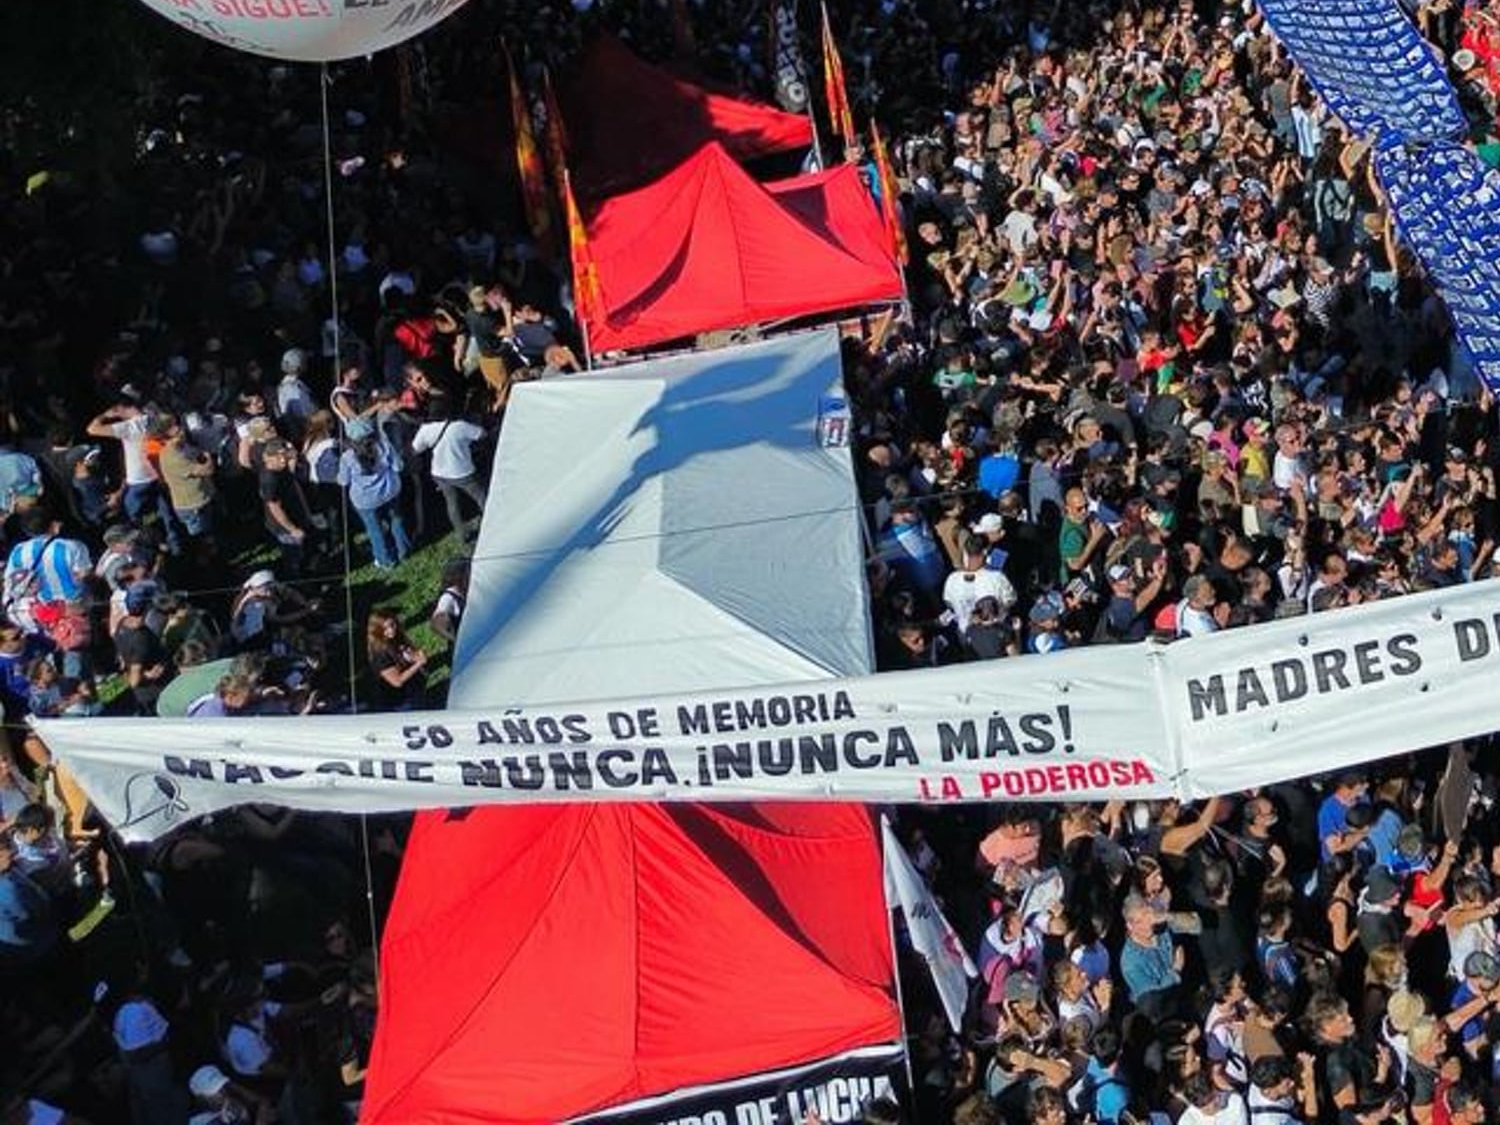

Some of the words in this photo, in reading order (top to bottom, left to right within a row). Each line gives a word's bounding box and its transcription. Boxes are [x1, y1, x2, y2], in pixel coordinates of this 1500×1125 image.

[1187, 632, 1422, 721] MADRES
[402, 725, 454, 750] 50
[477, 709, 592, 745] AÑOS
[607, 708, 660, 741] DE
[678, 690, 856, 737] MEMORIA
[937, 703, 1075, 762] MÁS!
[917, 778, 960, 802] LA
[981, 758, 1155, 799] PODEROSA
